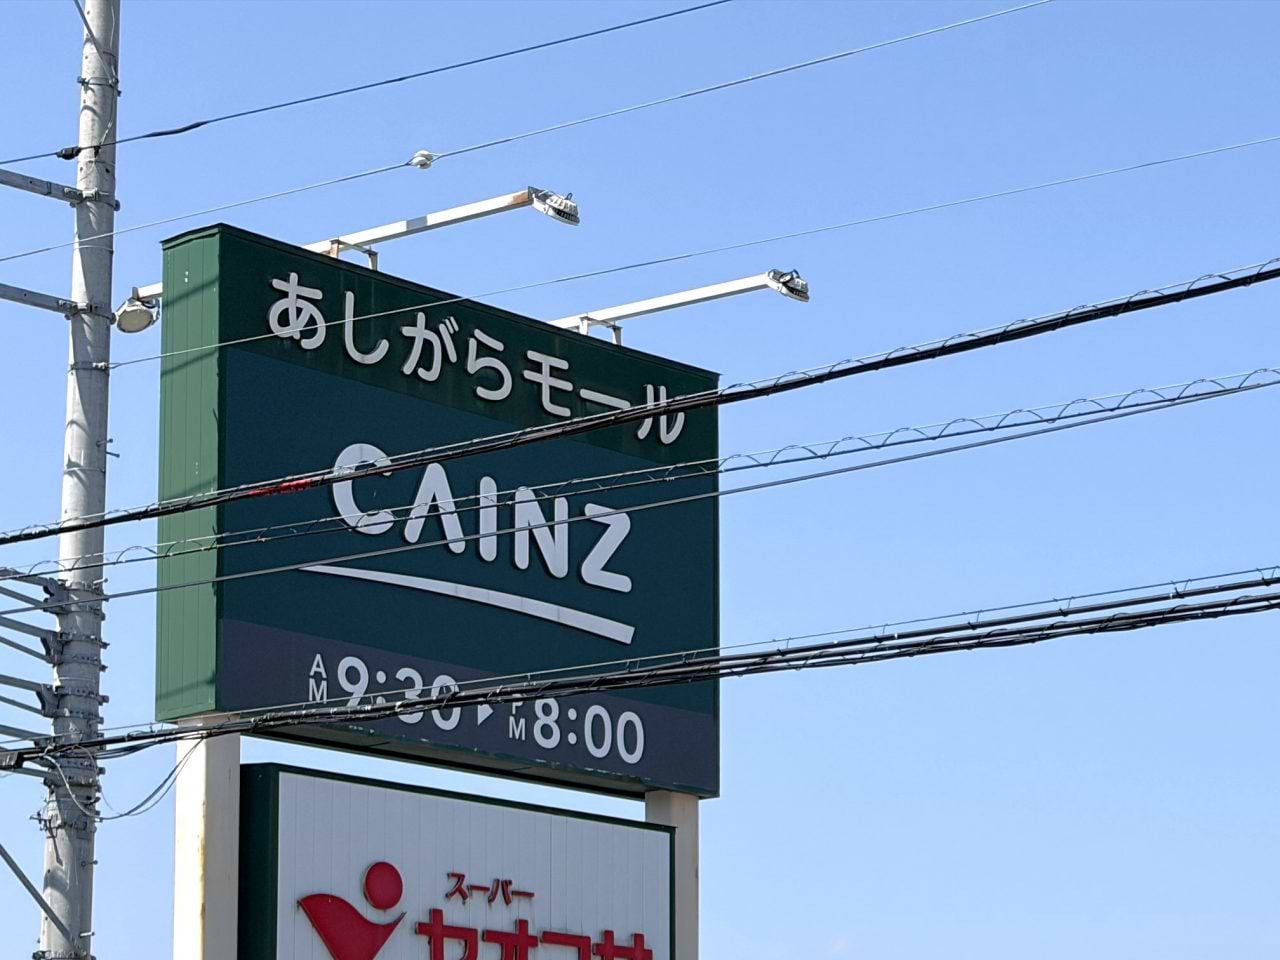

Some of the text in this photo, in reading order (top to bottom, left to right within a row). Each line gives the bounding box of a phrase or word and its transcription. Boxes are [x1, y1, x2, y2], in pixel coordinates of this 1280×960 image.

[269, 272, 685, 444] あしがらモール
[332, 443, 632, 592] CAINZ
[337, 656, 461, 731] 9:30
[533, 696, 644, 764] 8:00
[446, 873, 534, 906] スーパー
